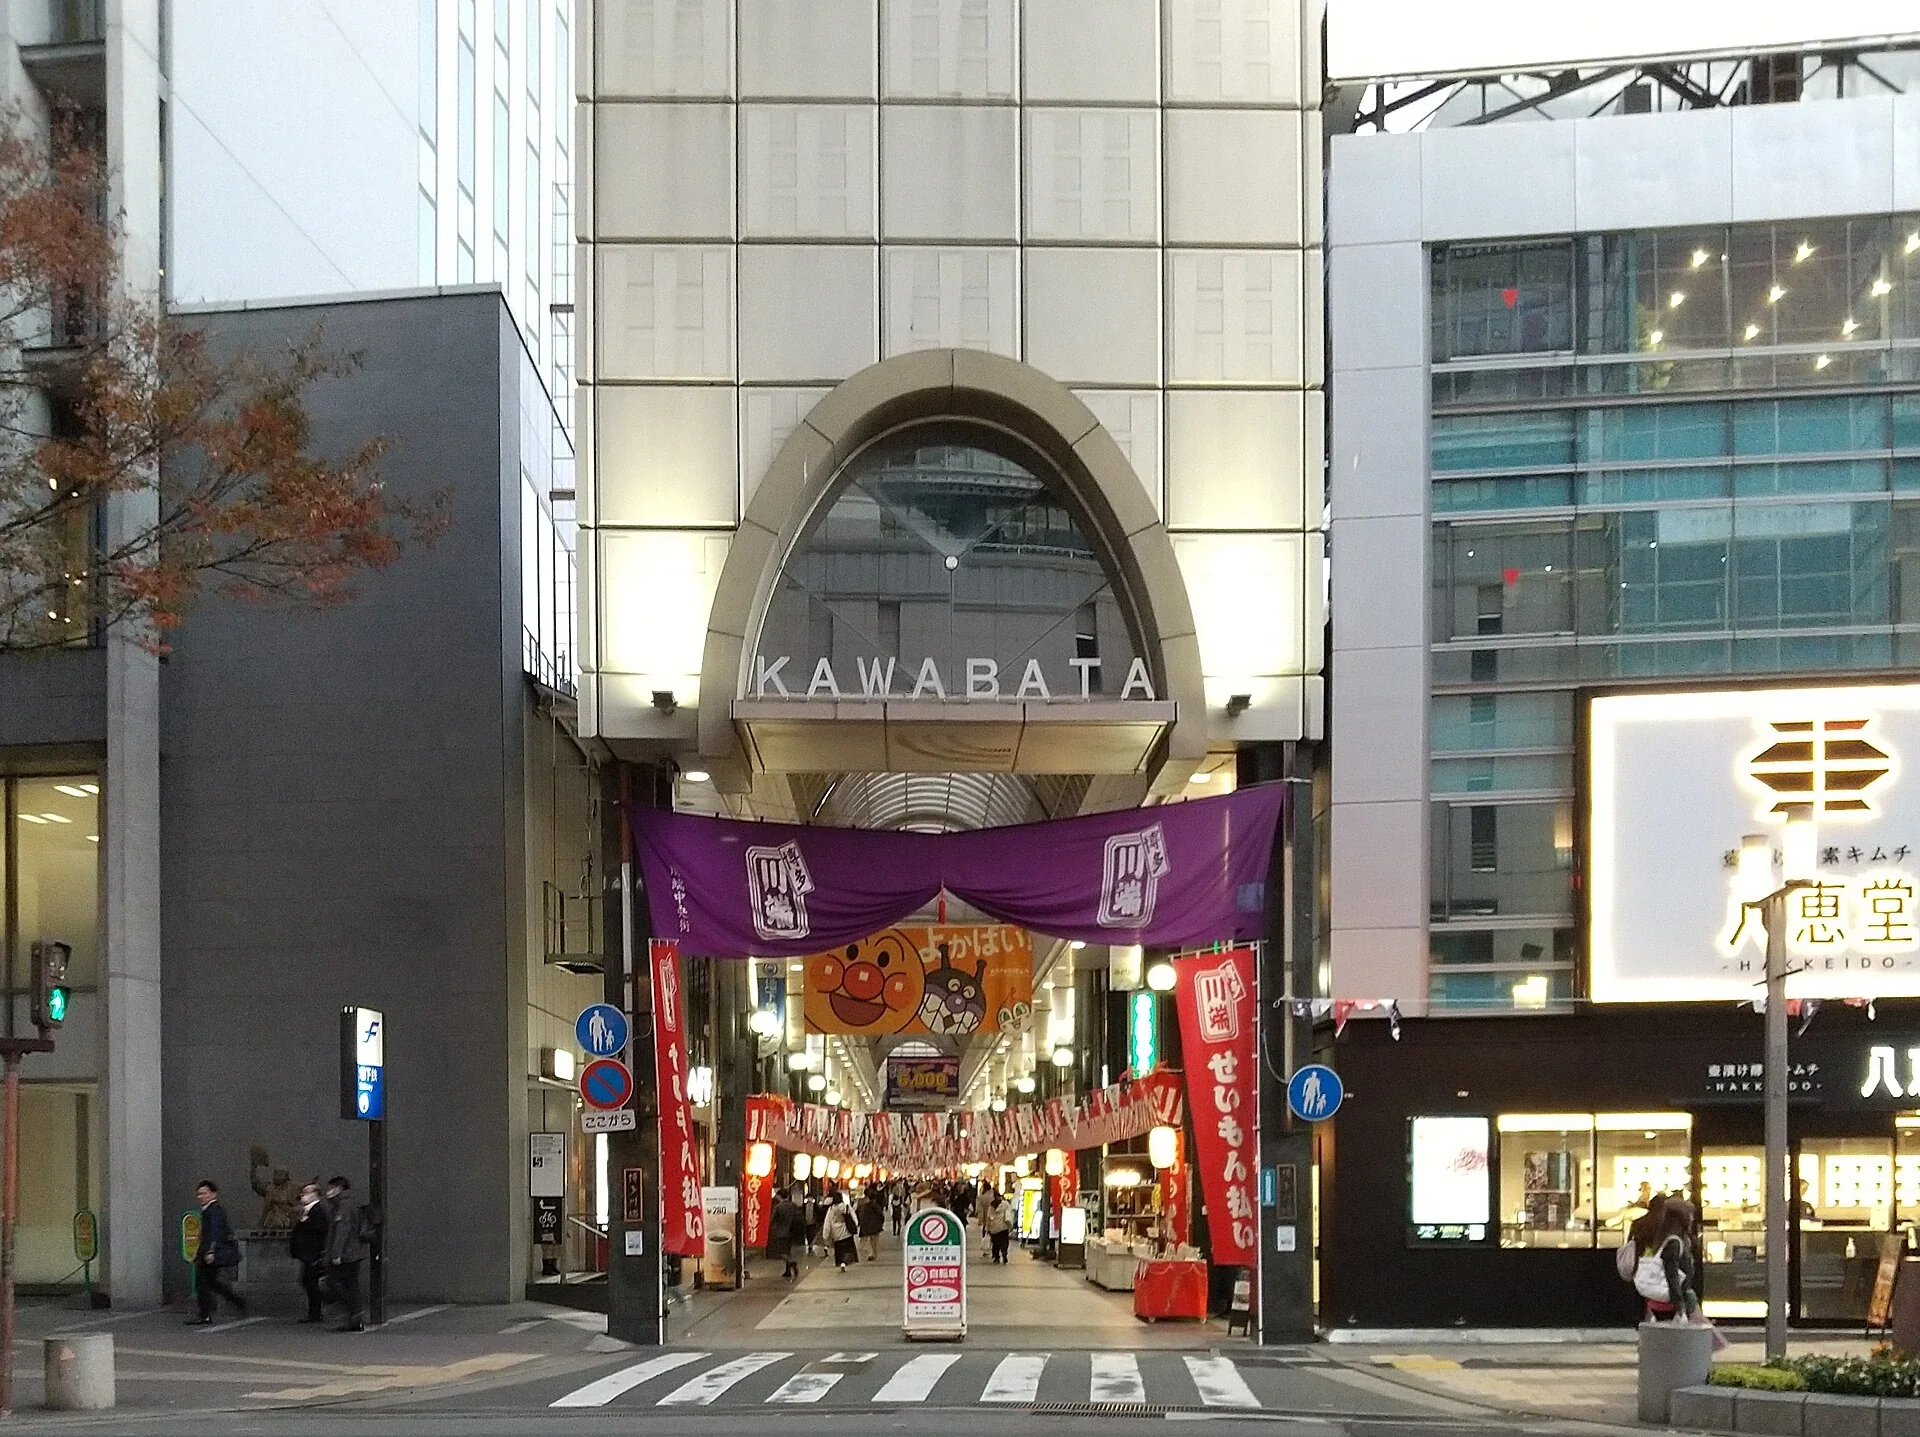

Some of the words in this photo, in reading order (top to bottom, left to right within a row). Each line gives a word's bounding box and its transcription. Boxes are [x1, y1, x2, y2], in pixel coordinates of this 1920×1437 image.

[756, 655, 1155, 701] KAWABATA
[757, 858, 795, 929] 川端
[1112, 845, 1148, 917] 川端
[1205, 977, 1231, 1032] 川端
[585, 1114, 631, 1128] ここから
[1207, 1050, 1254, 1249] せいもん払い
